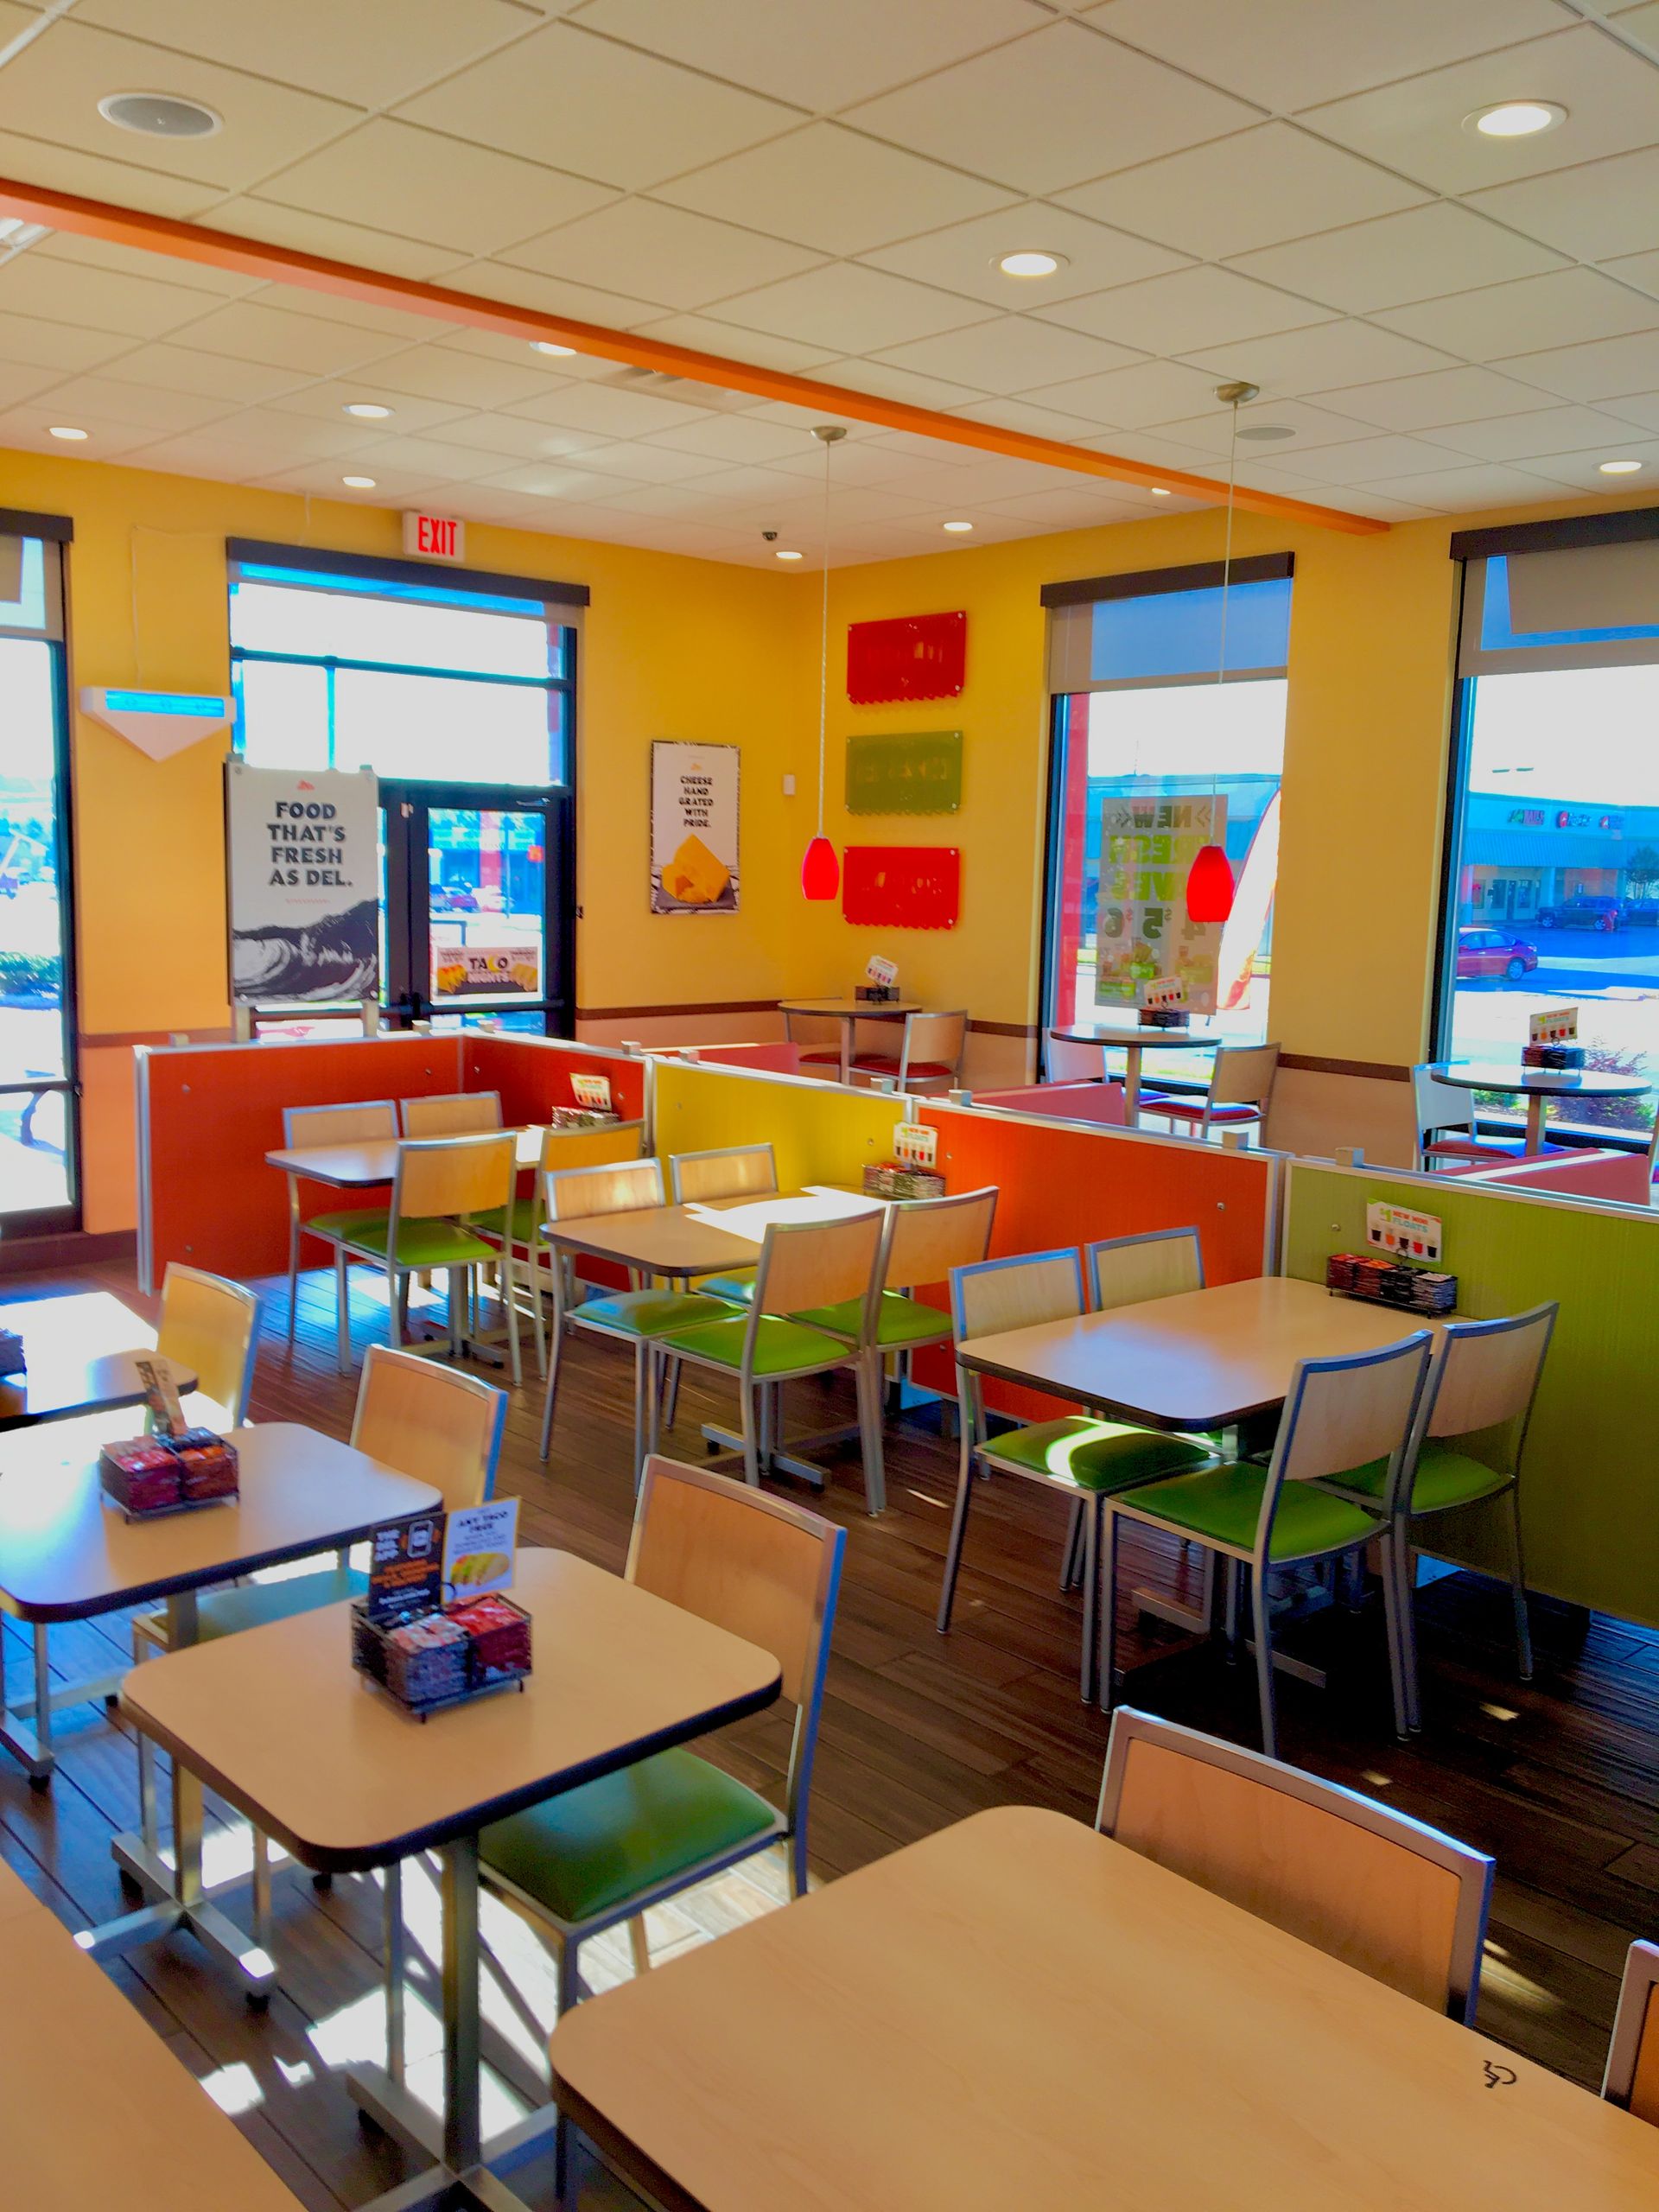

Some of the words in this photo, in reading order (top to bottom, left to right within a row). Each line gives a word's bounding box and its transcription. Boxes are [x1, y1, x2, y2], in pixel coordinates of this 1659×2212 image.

[418, 516, 457, 556] EXIT
[679, 775, 714, 786] CHEESE
[683, 786, 709, 796] HAND
[677, 797, 715, 807] GRATED
[276, 801, 337, 820] FOOD
[684, 808, 709, 817] WITH
[683, 818, 713, 829] PRIDE.
[267, 823, 346, 843] THAT'S
[271, 847, 343, 864] FRESH
[269, 868, 300, 887] AS
[307, 870, 353, 888] DEL.
